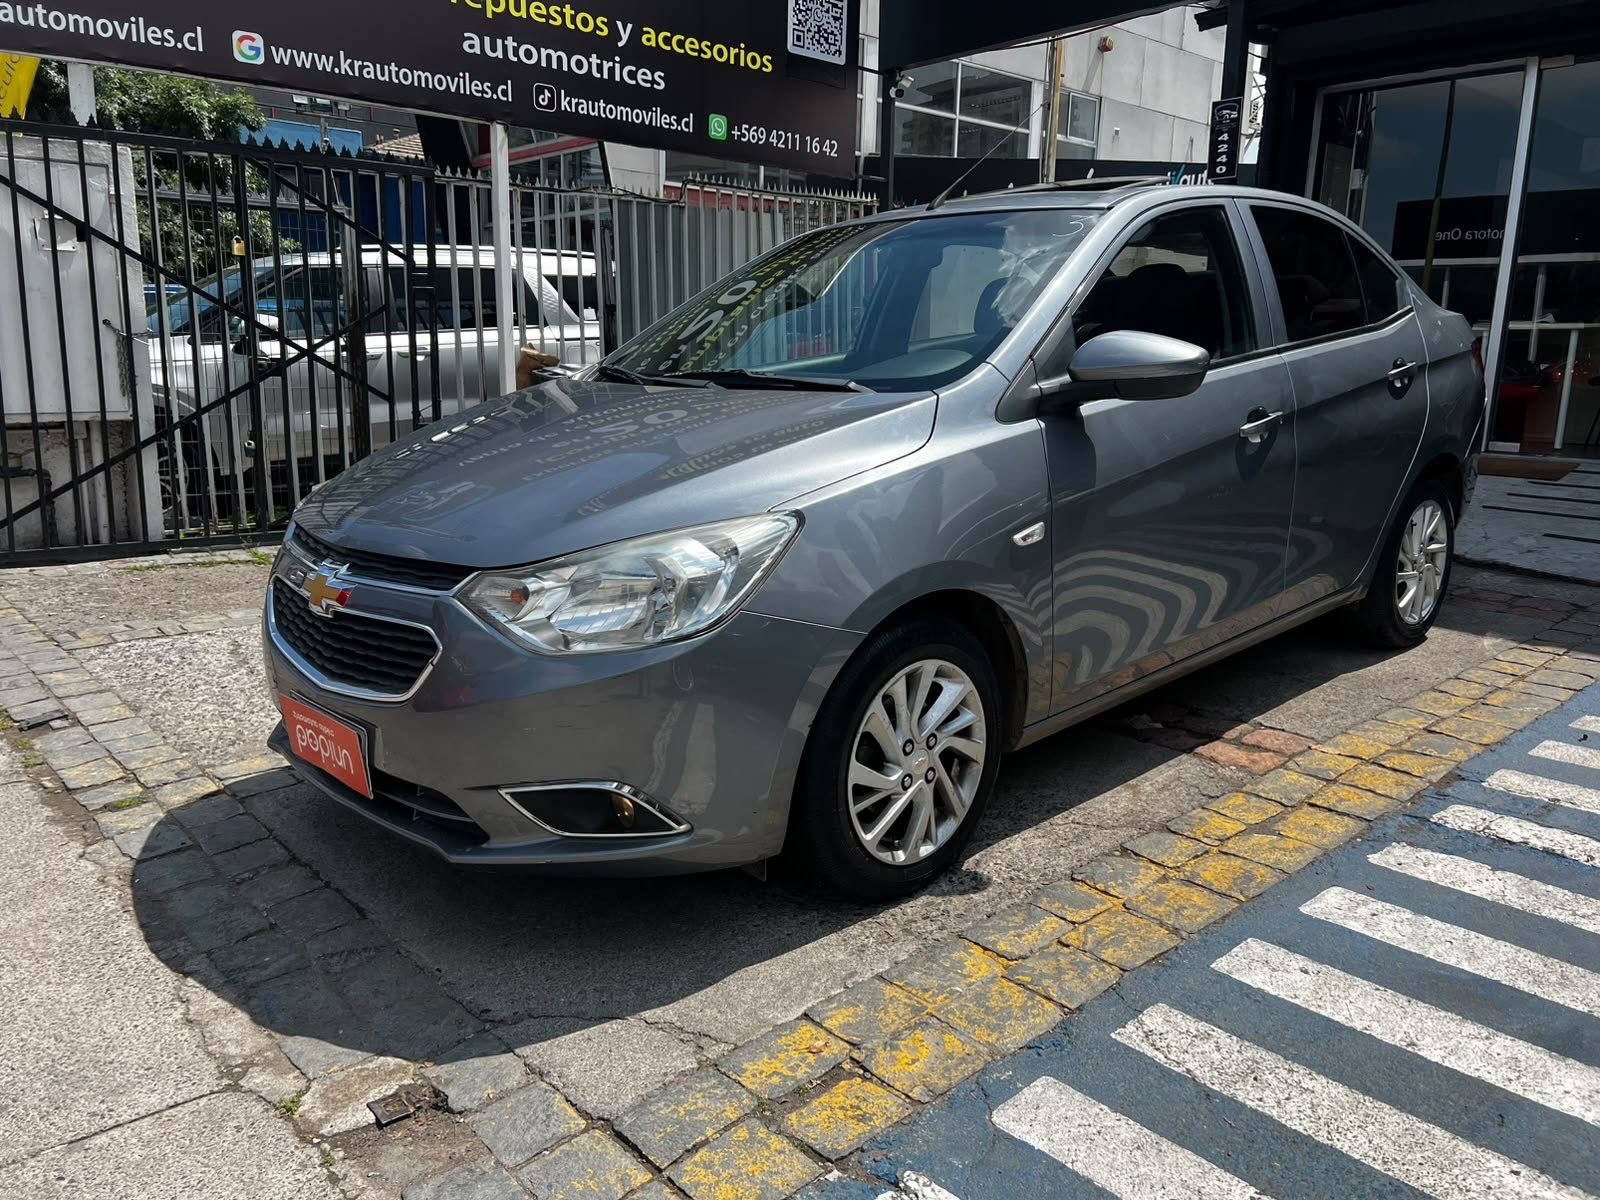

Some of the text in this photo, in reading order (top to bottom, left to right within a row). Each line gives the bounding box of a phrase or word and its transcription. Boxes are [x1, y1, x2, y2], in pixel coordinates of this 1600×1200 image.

[0, 2, 204, 53] automoviles.cl
[450, 0, 773, 73] puestos y accesorios
[270, 45, 513, 103] www.krautomoviles.cl
[462, 32, 666, 91] automotrices
[560, 90, 694, 133] krautomoviles.cl
[731, 124, 767, 145] +569
[769, 129, 800, 151] 4211
